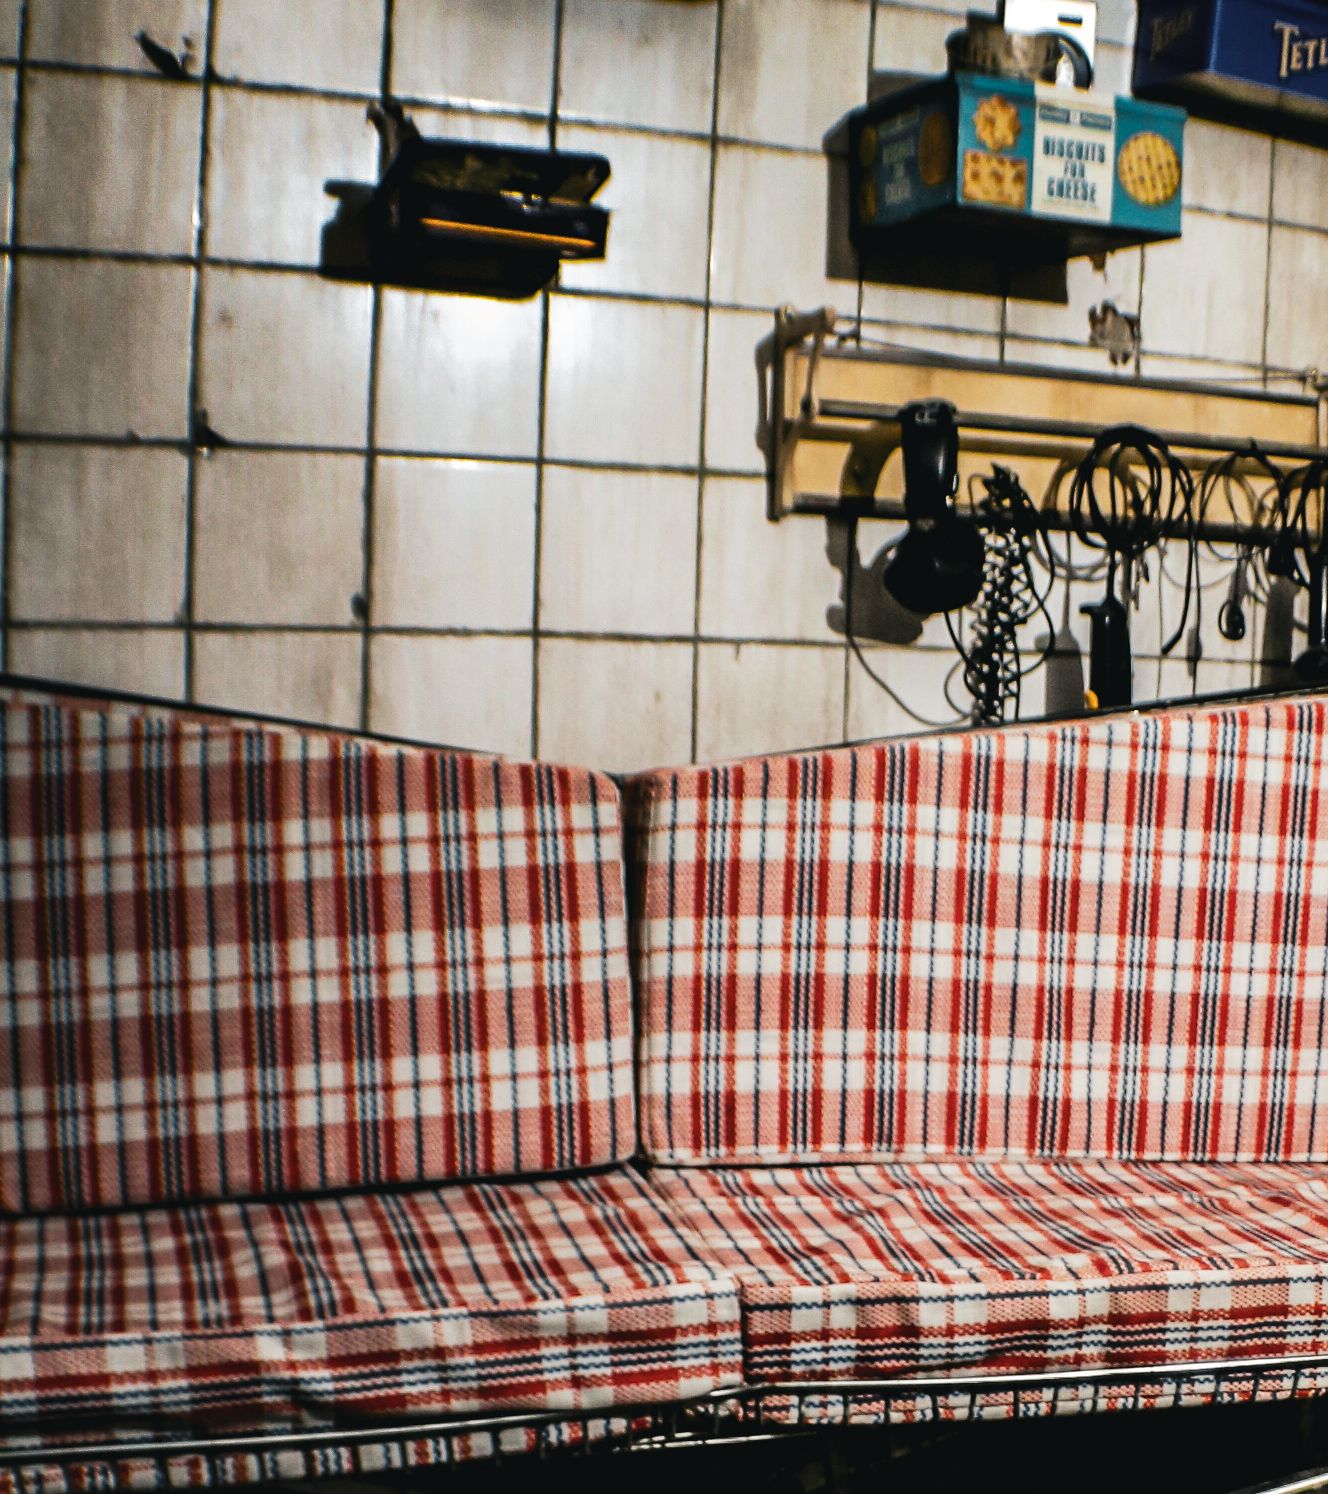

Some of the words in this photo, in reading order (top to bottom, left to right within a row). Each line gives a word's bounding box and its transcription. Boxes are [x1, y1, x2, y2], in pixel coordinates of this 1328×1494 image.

[1042, 134, 1106, 163] BISCUITS
[1063, 159, 1085, 178] FOR
[1046, 175, 1096, 203] CHEESE
